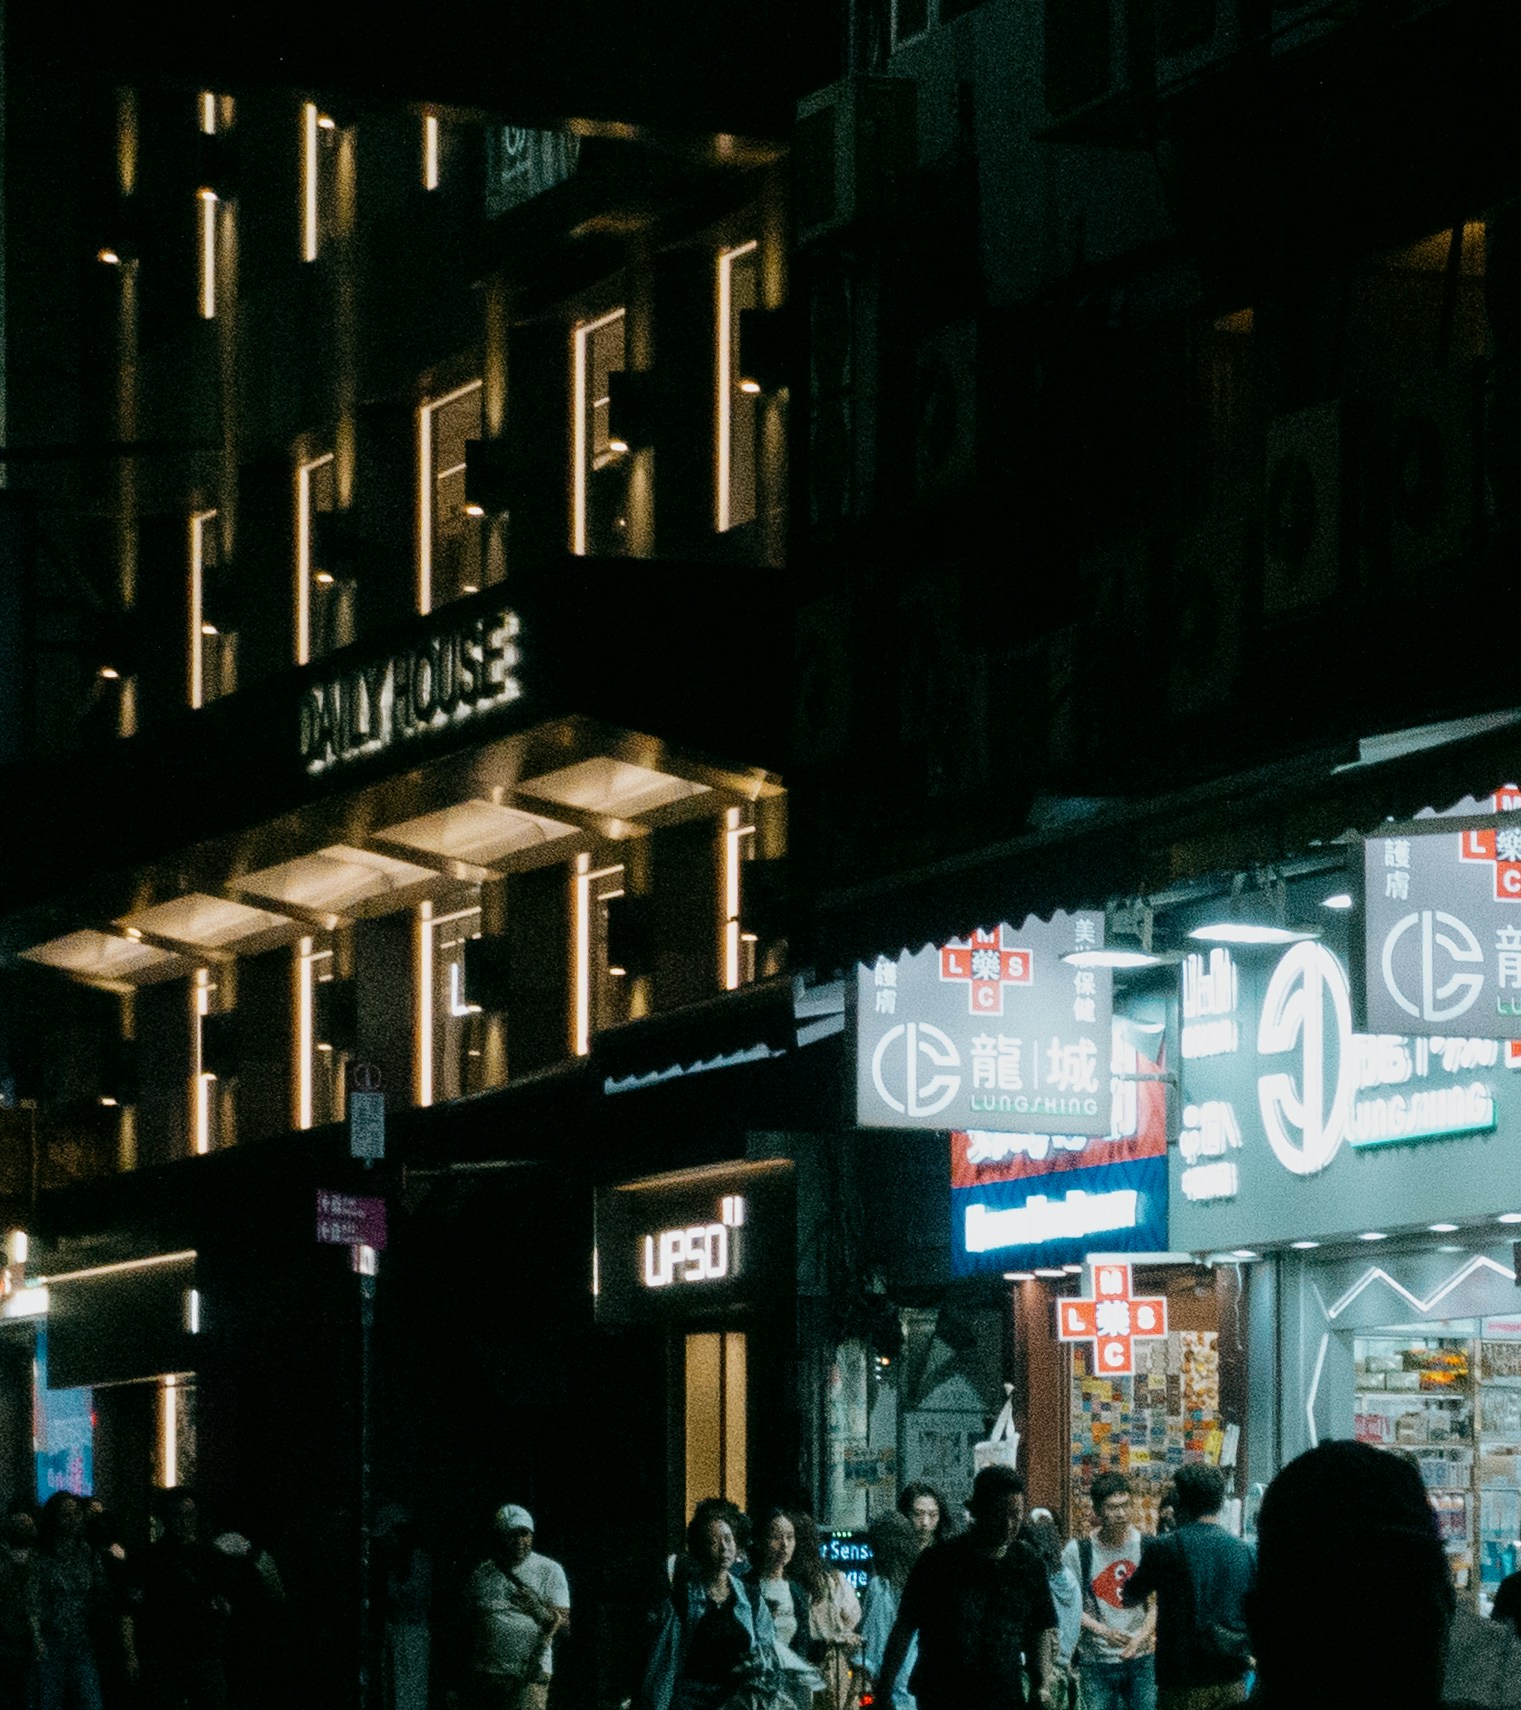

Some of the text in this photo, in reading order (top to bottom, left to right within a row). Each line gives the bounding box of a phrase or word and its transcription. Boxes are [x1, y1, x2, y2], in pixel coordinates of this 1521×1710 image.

[1470, 830, 1486, 854] L
[1384, 838, 1411, 900] 護膚
[1503, 870, 1521, 893] C
[950, 955, 962, 974] L
[1009, 956, 1024, 976] S
[1073, 918, 1097, 1022] 美保健
[977, 987, 994, 1007] C
[645, 1223, 728, 1287] UPSO
[1100, 1269, 1123, 1295] M
[1069, 1308, 1084, 1330] L
[1137, 1306, 1156, 1330] S
[1104, 1340, 1125, 1368] C
